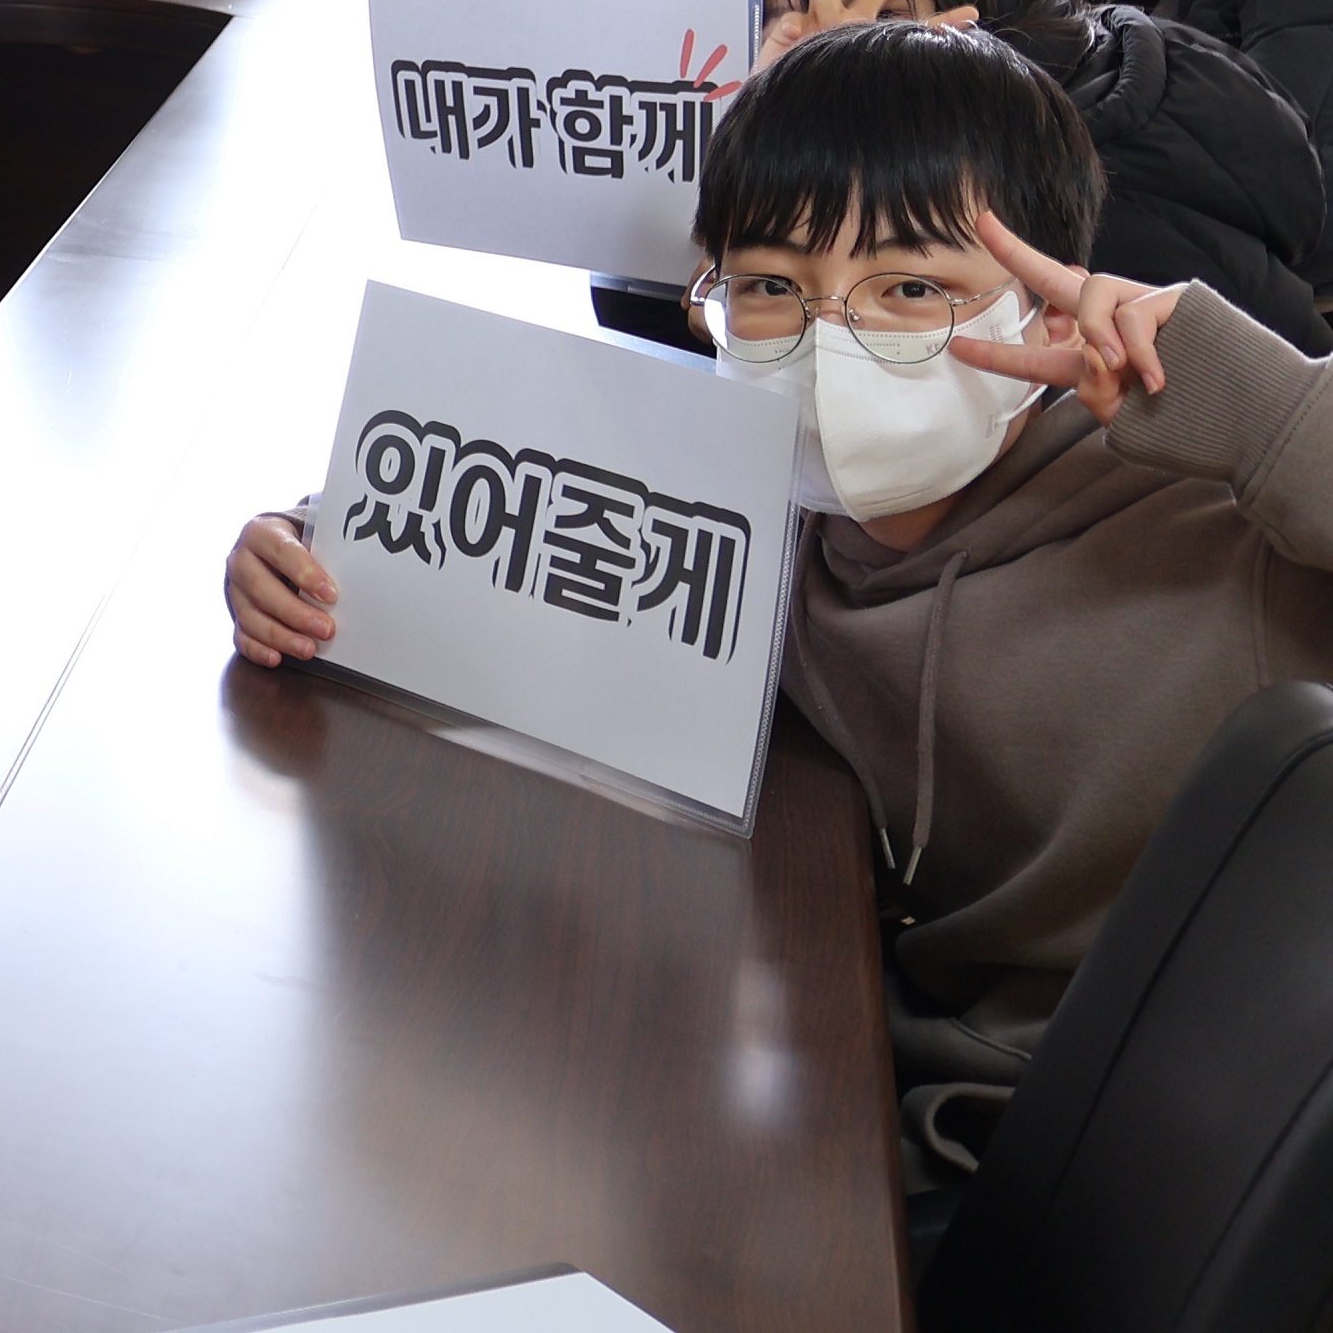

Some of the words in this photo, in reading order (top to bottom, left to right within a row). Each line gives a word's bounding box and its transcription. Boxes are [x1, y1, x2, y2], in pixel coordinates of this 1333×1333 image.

[391, 60, 543, 169] 내가
[547, 69, 719, 184] 함께
[345, 410, 751, 664] 있어줄게
